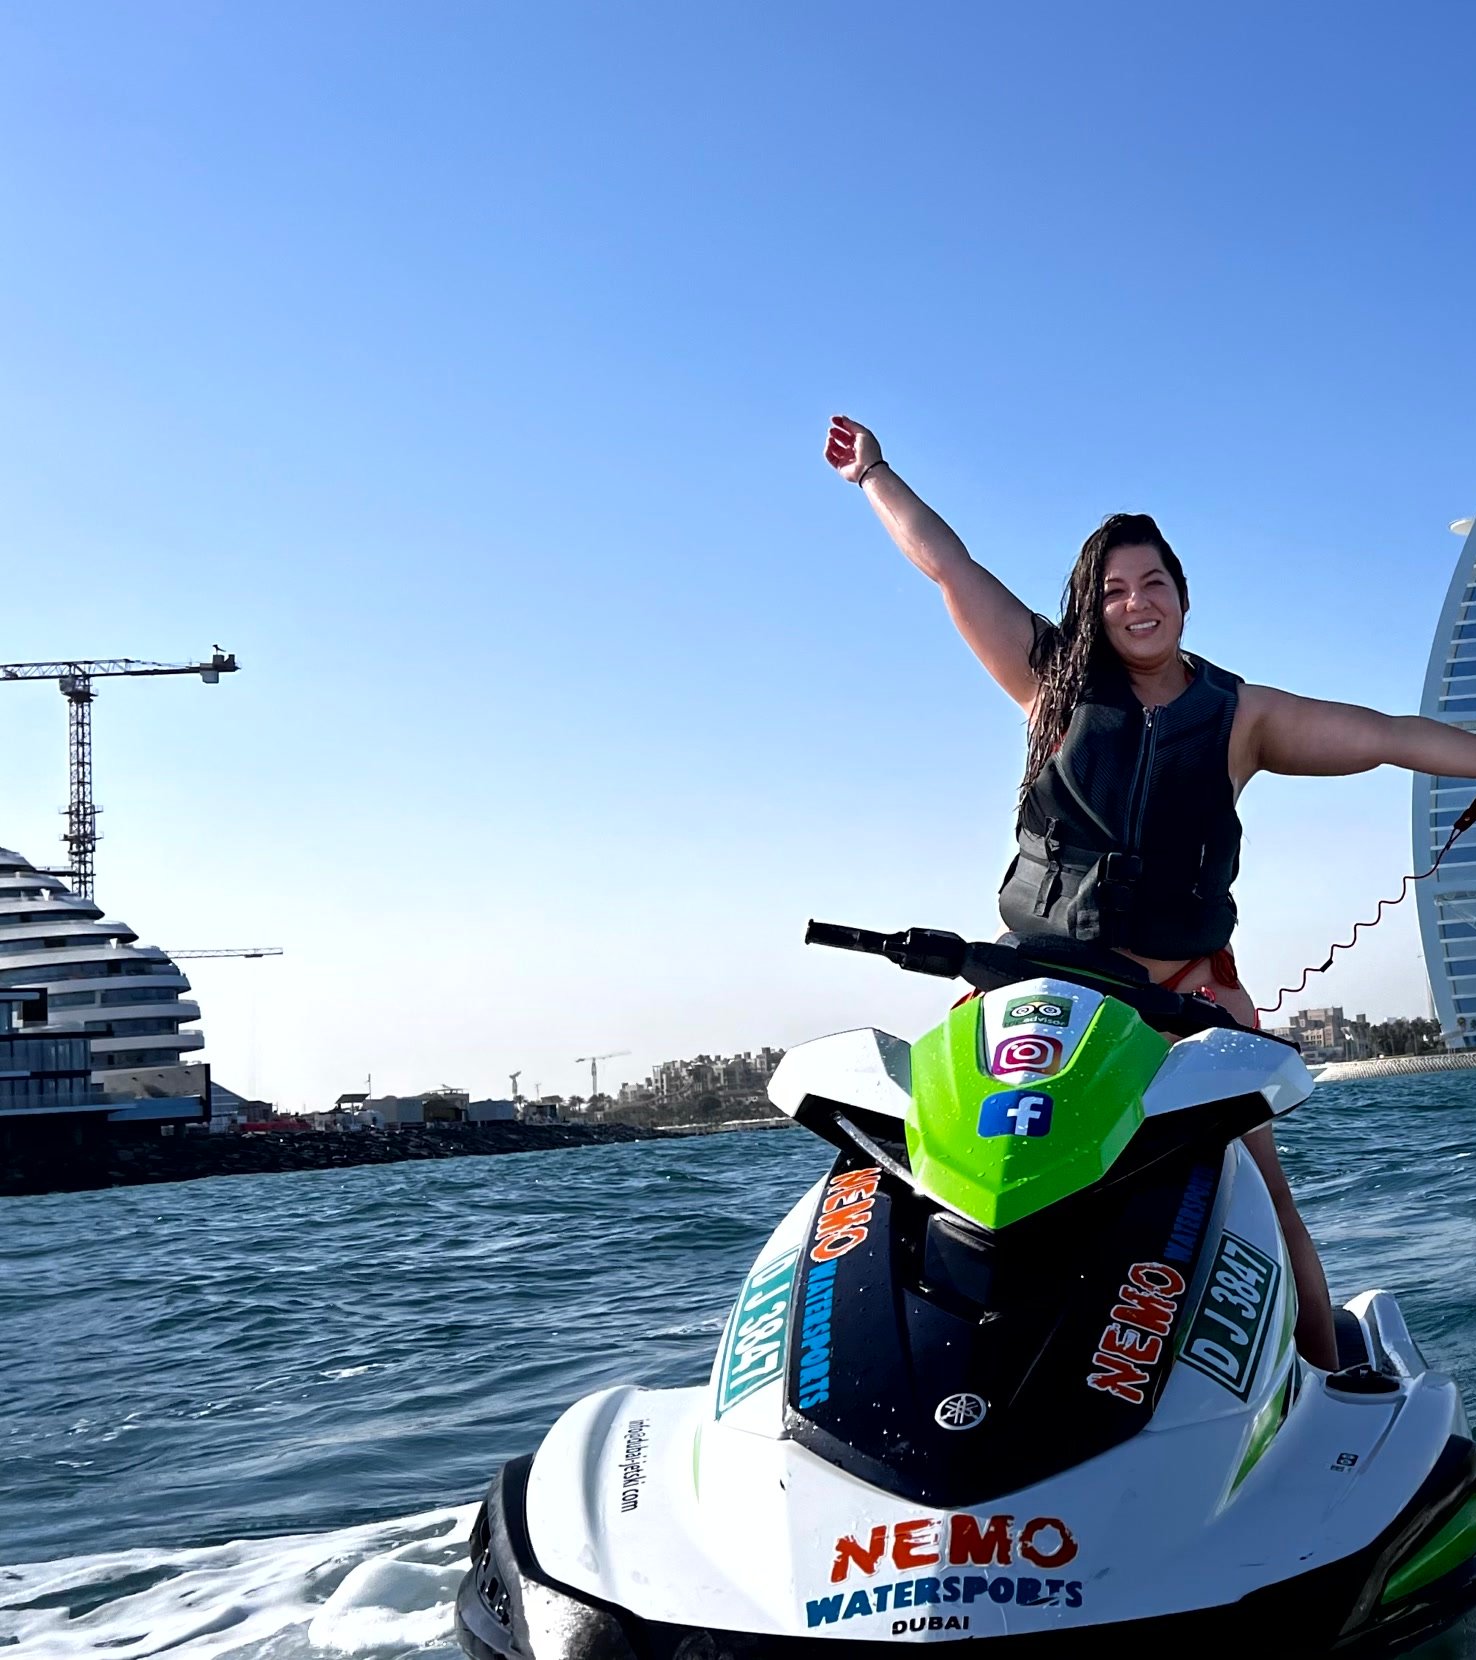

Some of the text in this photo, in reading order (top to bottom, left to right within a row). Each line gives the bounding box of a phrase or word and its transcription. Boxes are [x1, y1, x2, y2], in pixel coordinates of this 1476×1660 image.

[799, 1167, 882, 1409] NEMO WATERSPORTS
[1210, 1240, 1267, 1319] 3847
[730, 1301, 787, 1390] 3847
[1087, 1262, 1185, 1404] NEMO
[829, 1514, 1079, 1583] NEMO
[806, 1576, 1082, 1627] WATERSPORTS
[892, 1616, 969, 1634] DUBAI
